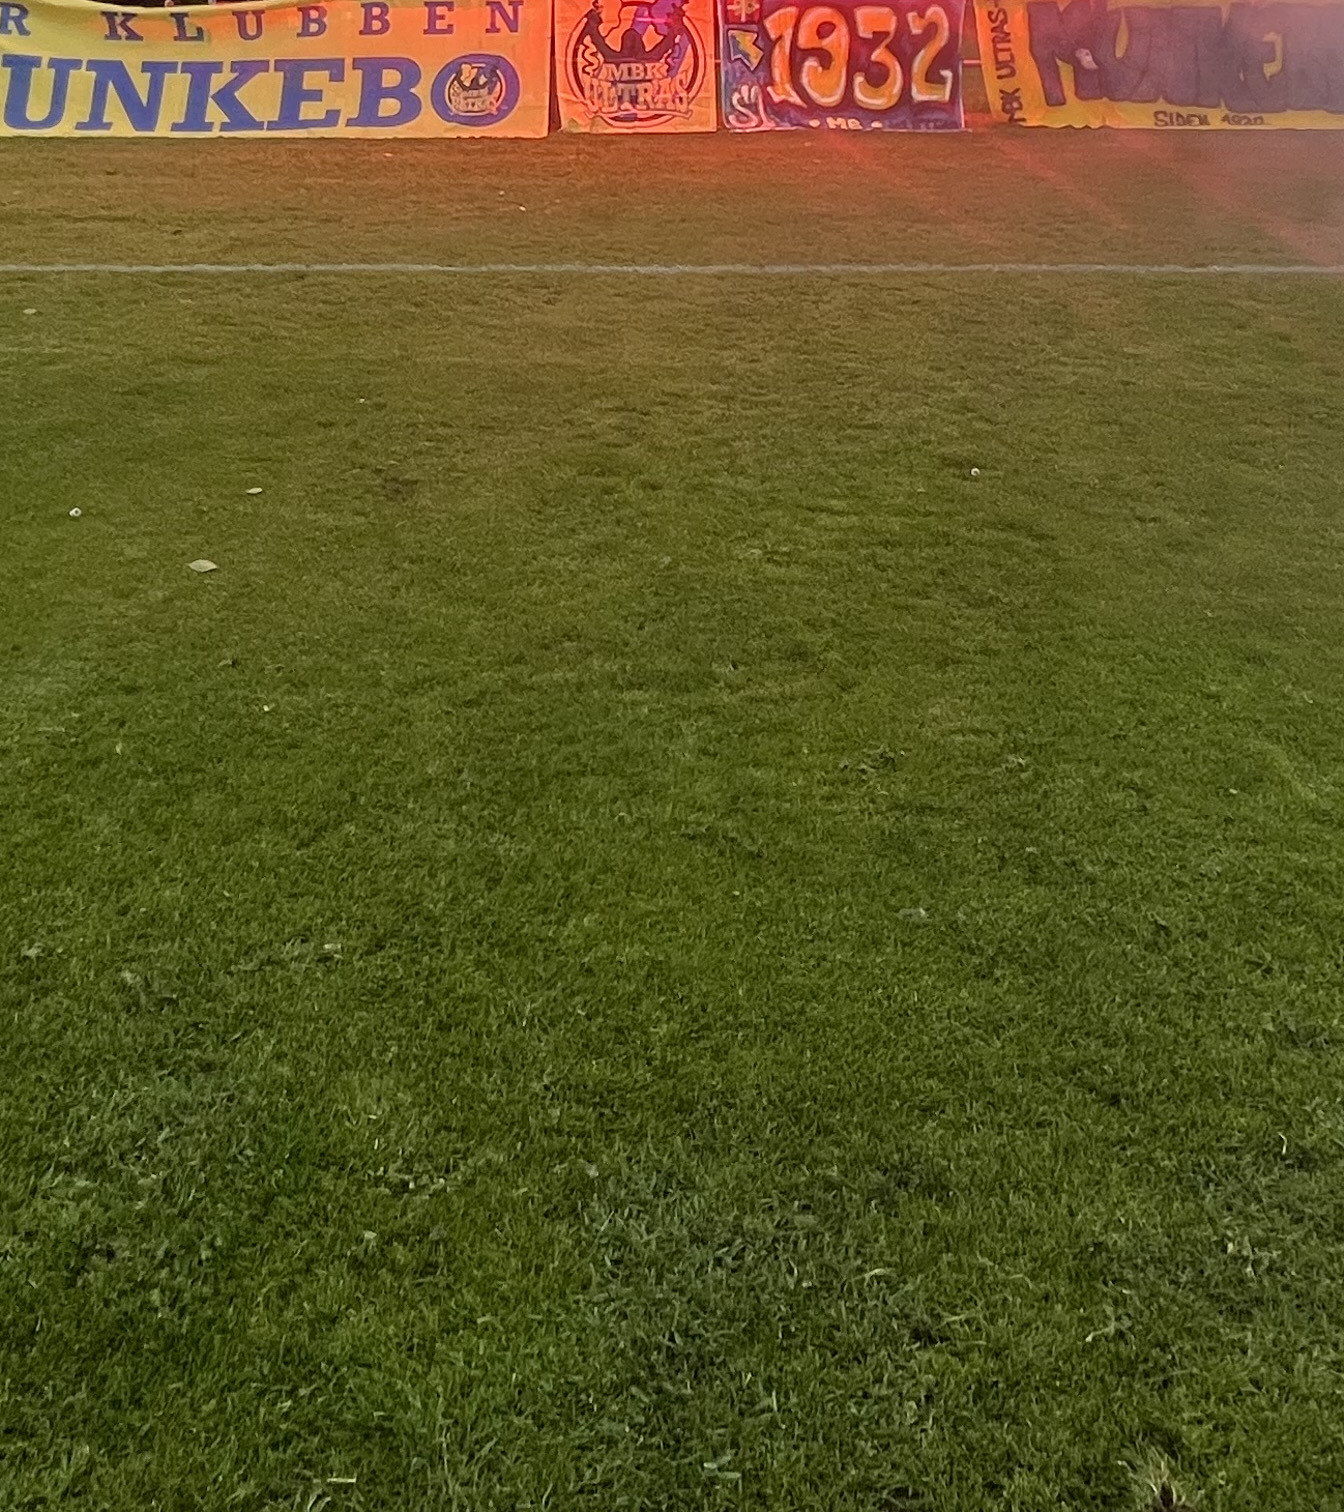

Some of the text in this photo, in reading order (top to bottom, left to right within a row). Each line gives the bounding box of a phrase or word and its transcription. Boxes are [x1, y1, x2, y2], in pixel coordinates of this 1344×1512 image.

[606, 63, 664, 80] MBK
[764, 3, 954, 111] 1932
[583, 70, 689, 114] ULTRAS
